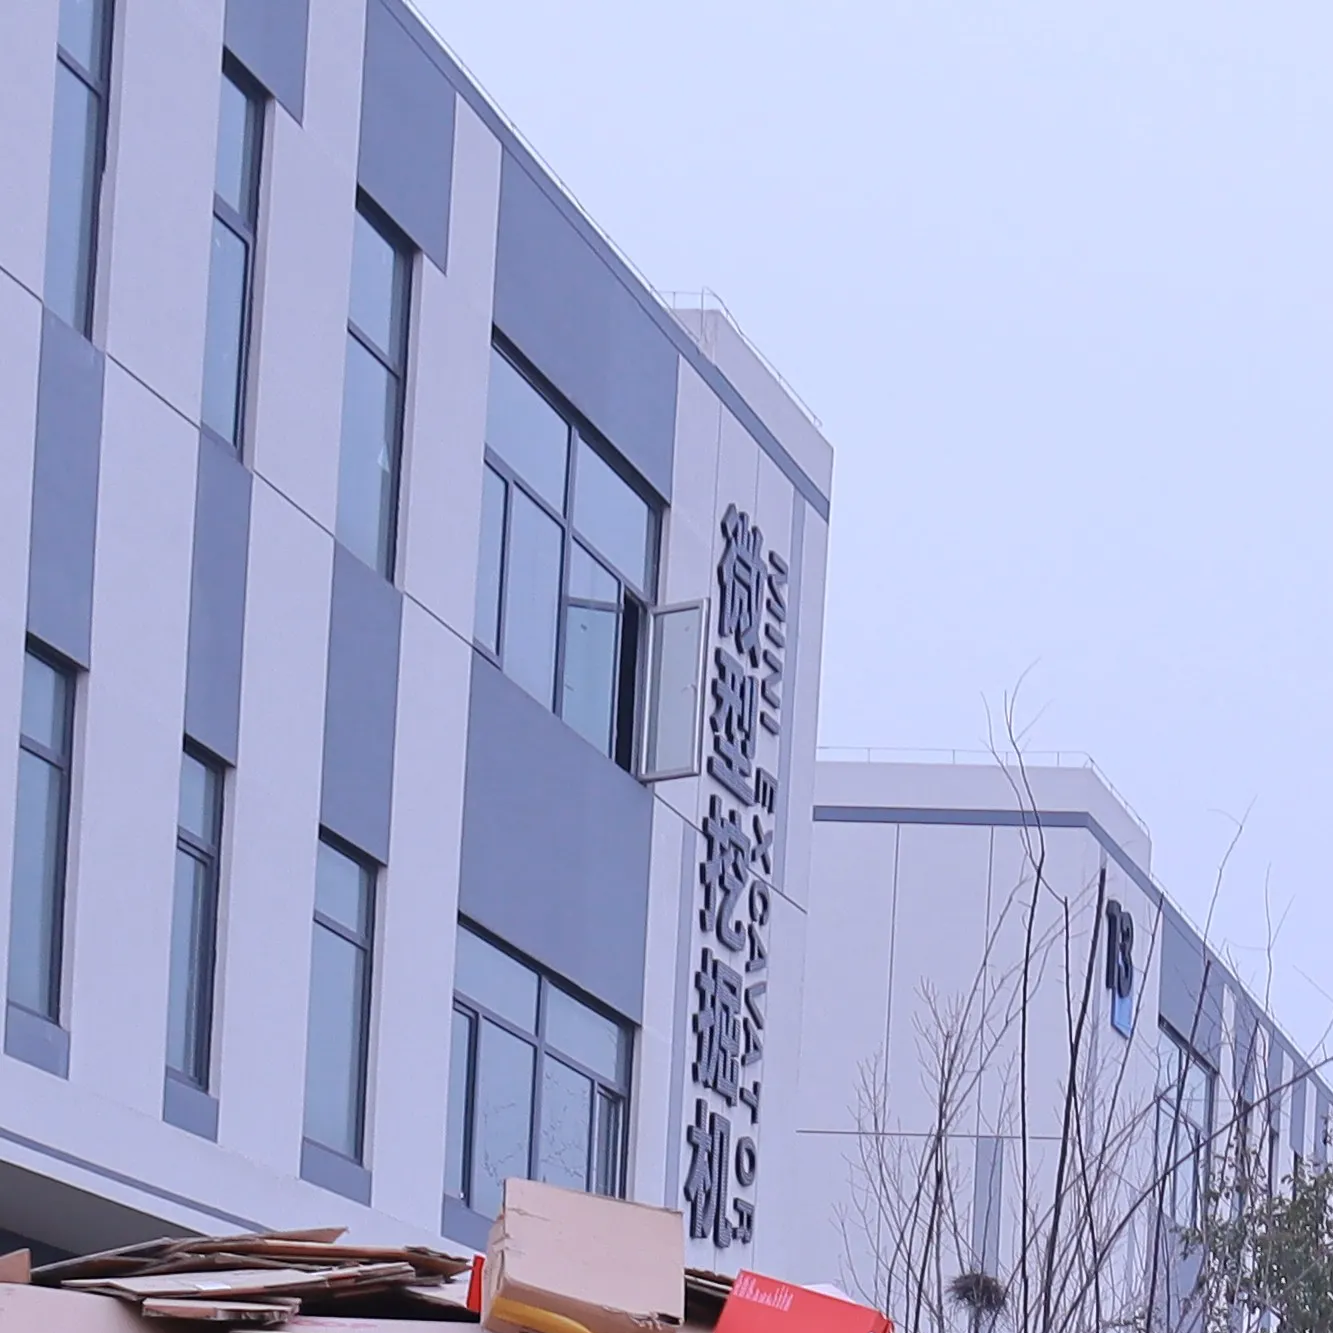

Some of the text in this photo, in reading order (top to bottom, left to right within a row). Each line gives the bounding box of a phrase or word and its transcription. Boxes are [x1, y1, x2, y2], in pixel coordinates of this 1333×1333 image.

[684, 502, 768, 1249] 微型挖掘机
[760, 550, 789, 736] MINI
[730, 767, 778, 1245] EXCAVATOR
